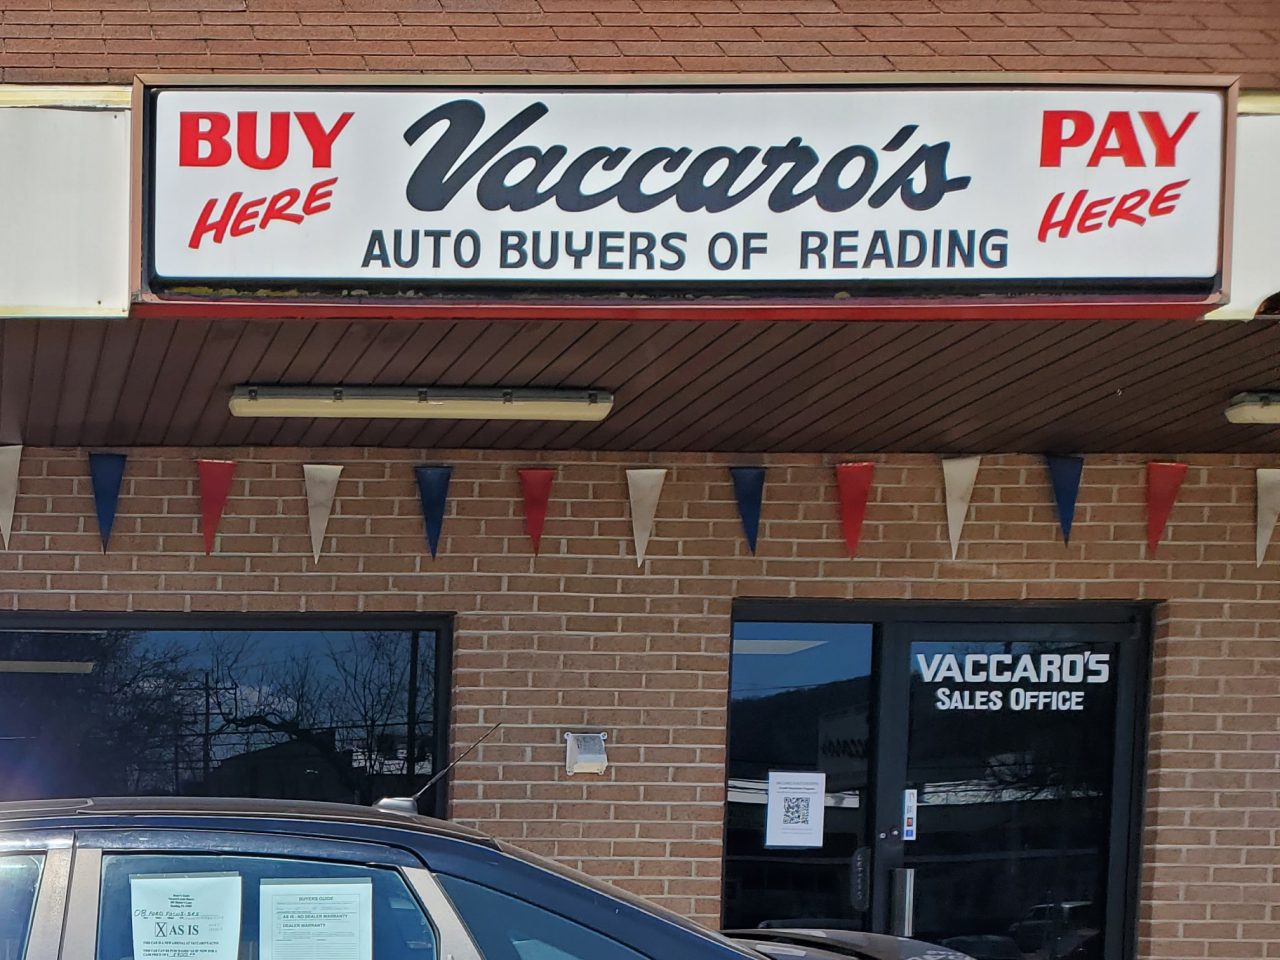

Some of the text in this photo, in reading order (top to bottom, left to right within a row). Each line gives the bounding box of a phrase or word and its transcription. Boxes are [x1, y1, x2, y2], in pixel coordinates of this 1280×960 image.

[179, 111, 353, 170] BUY
[403, 99, 972, 213] Vaccaro's
[1039, 111, 1197, 168] PAY
[188, 177, 338, 250] HERE
[1037, 179, 1188, 243] HERE
[361, 229, 1008, 271] AUTO BUYERS OF READING
[917, 651, 1110, 683] VACCARO'S
[936, 687, 1085, 711] SALES OFFICE
[169, 924, 185, 935] AS
[188, 924, 199, 935] IS
